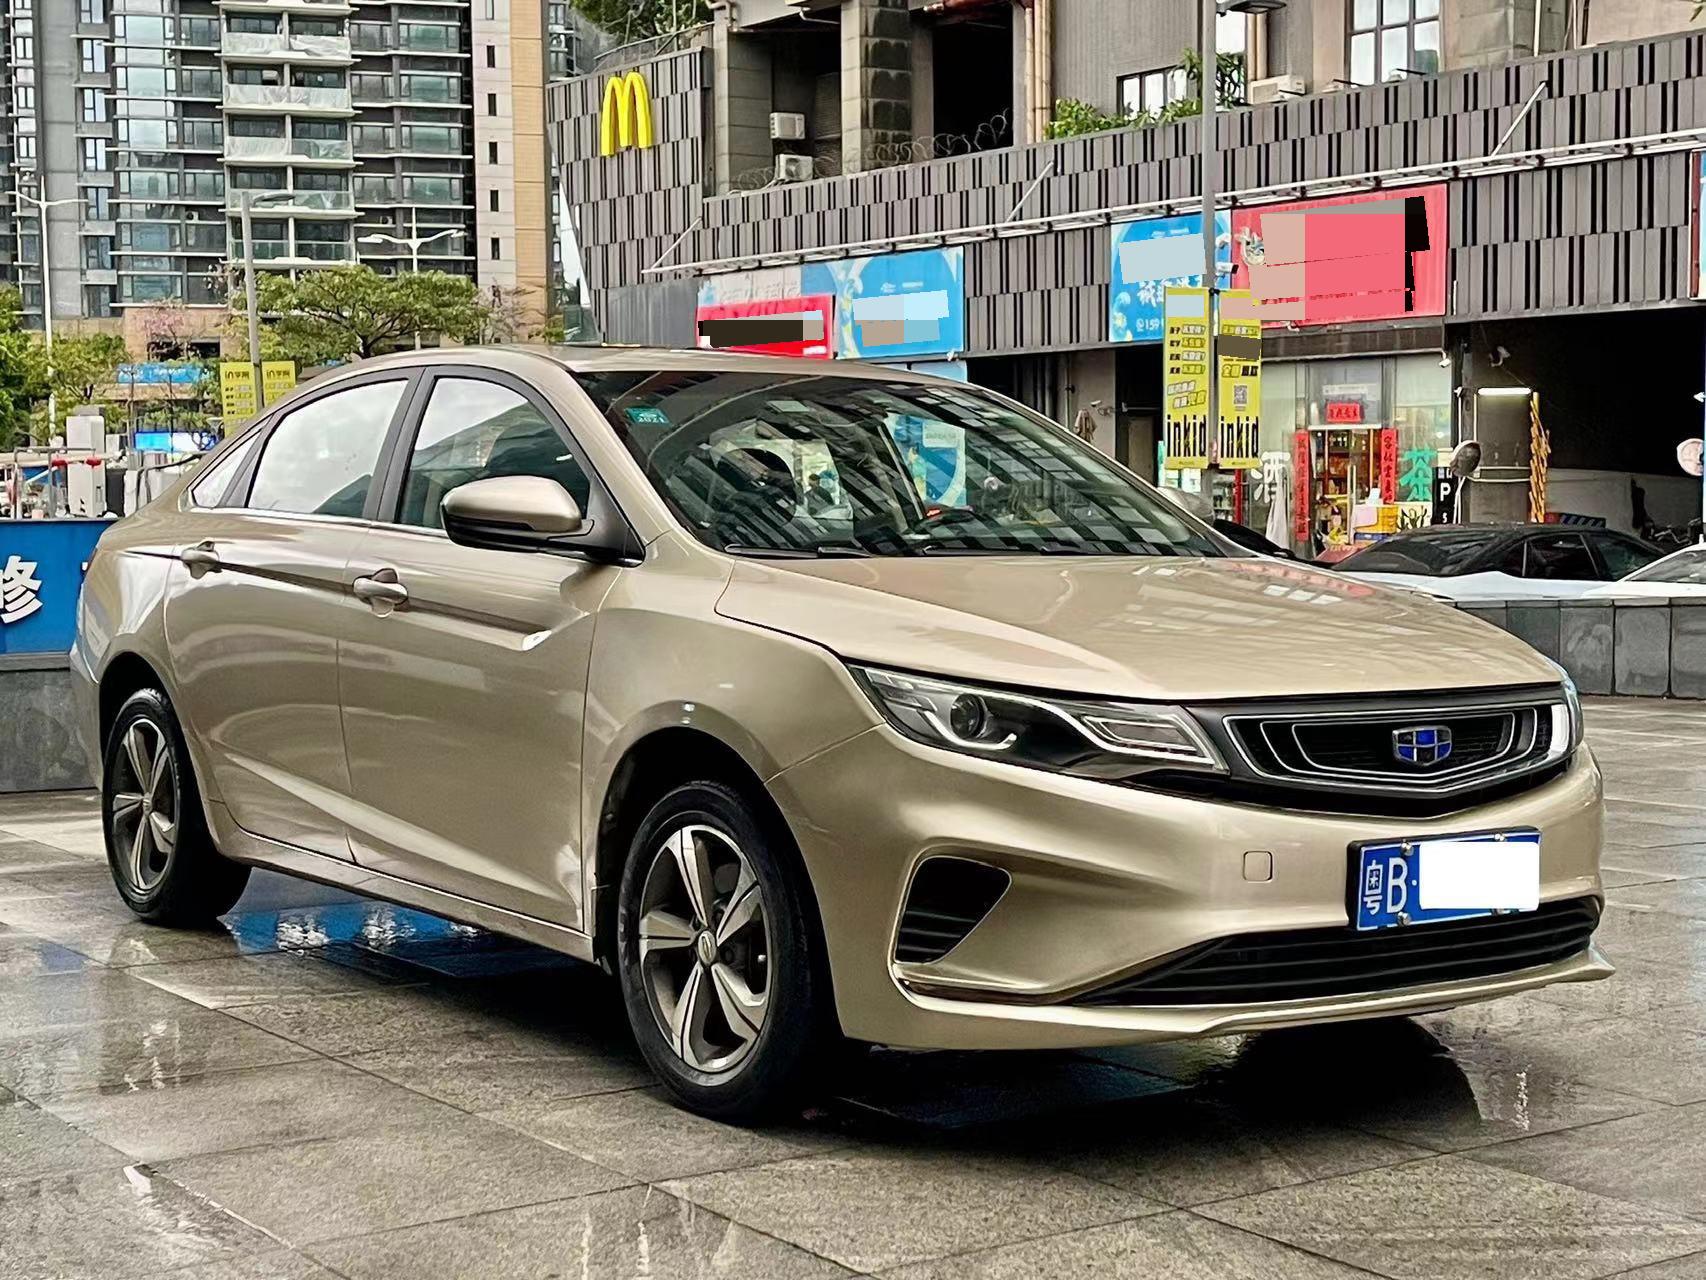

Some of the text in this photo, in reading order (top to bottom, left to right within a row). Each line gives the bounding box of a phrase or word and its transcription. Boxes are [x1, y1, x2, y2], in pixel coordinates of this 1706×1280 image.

[1167, 414, 1207, 457] inkid
[1220, 416, 1259, 458] inkid
[1440, 482, 1451, 502] P
